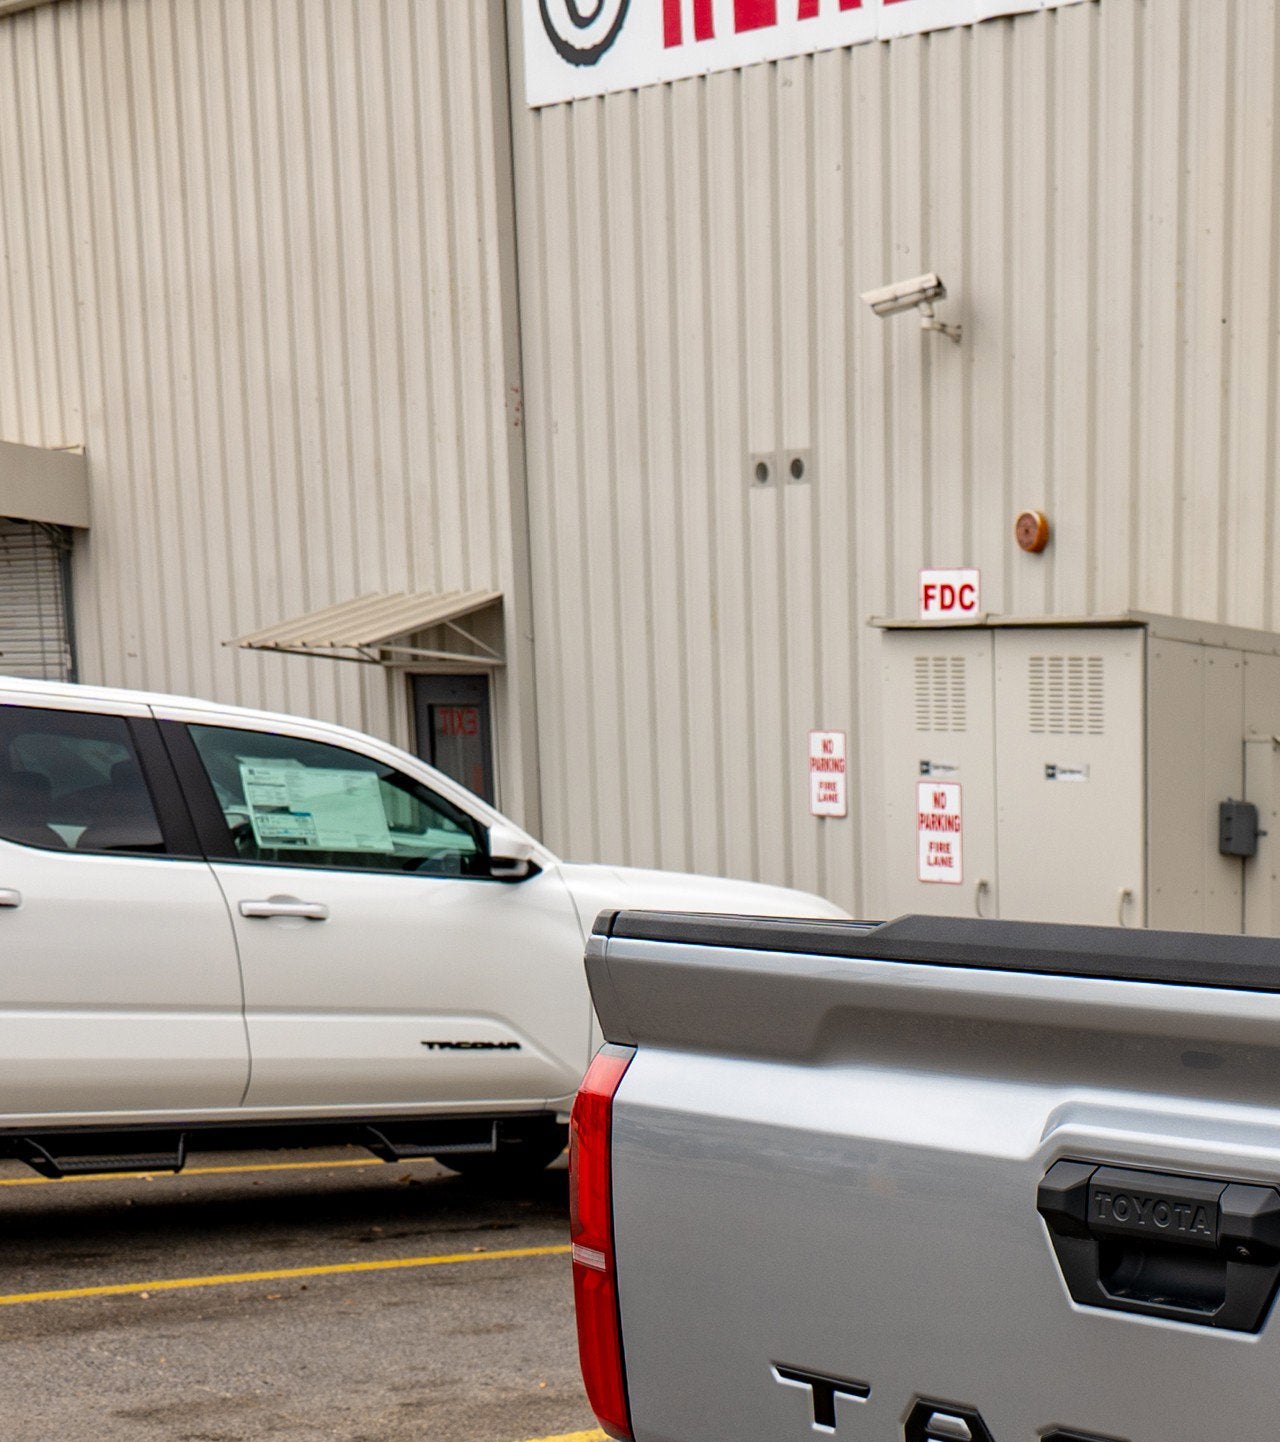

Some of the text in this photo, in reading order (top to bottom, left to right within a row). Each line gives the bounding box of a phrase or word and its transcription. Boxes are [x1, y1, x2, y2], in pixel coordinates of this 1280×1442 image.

[923, 583, 976, 611] FDC
[822, 739, 834, 754] NO
[810, 758, 845, 773] PARKING
[819, 781, 836, 791] FIRE
[818, 792, 838, 803] LANE
[933, 791, 947, 809] NO
[919, 813, 960, 833] PARKING
[929, 841, 951, 854] FIRE
[927, 855, 953, 868] LANE
[1095, 1191, 1211, 1235] TOYOTA
